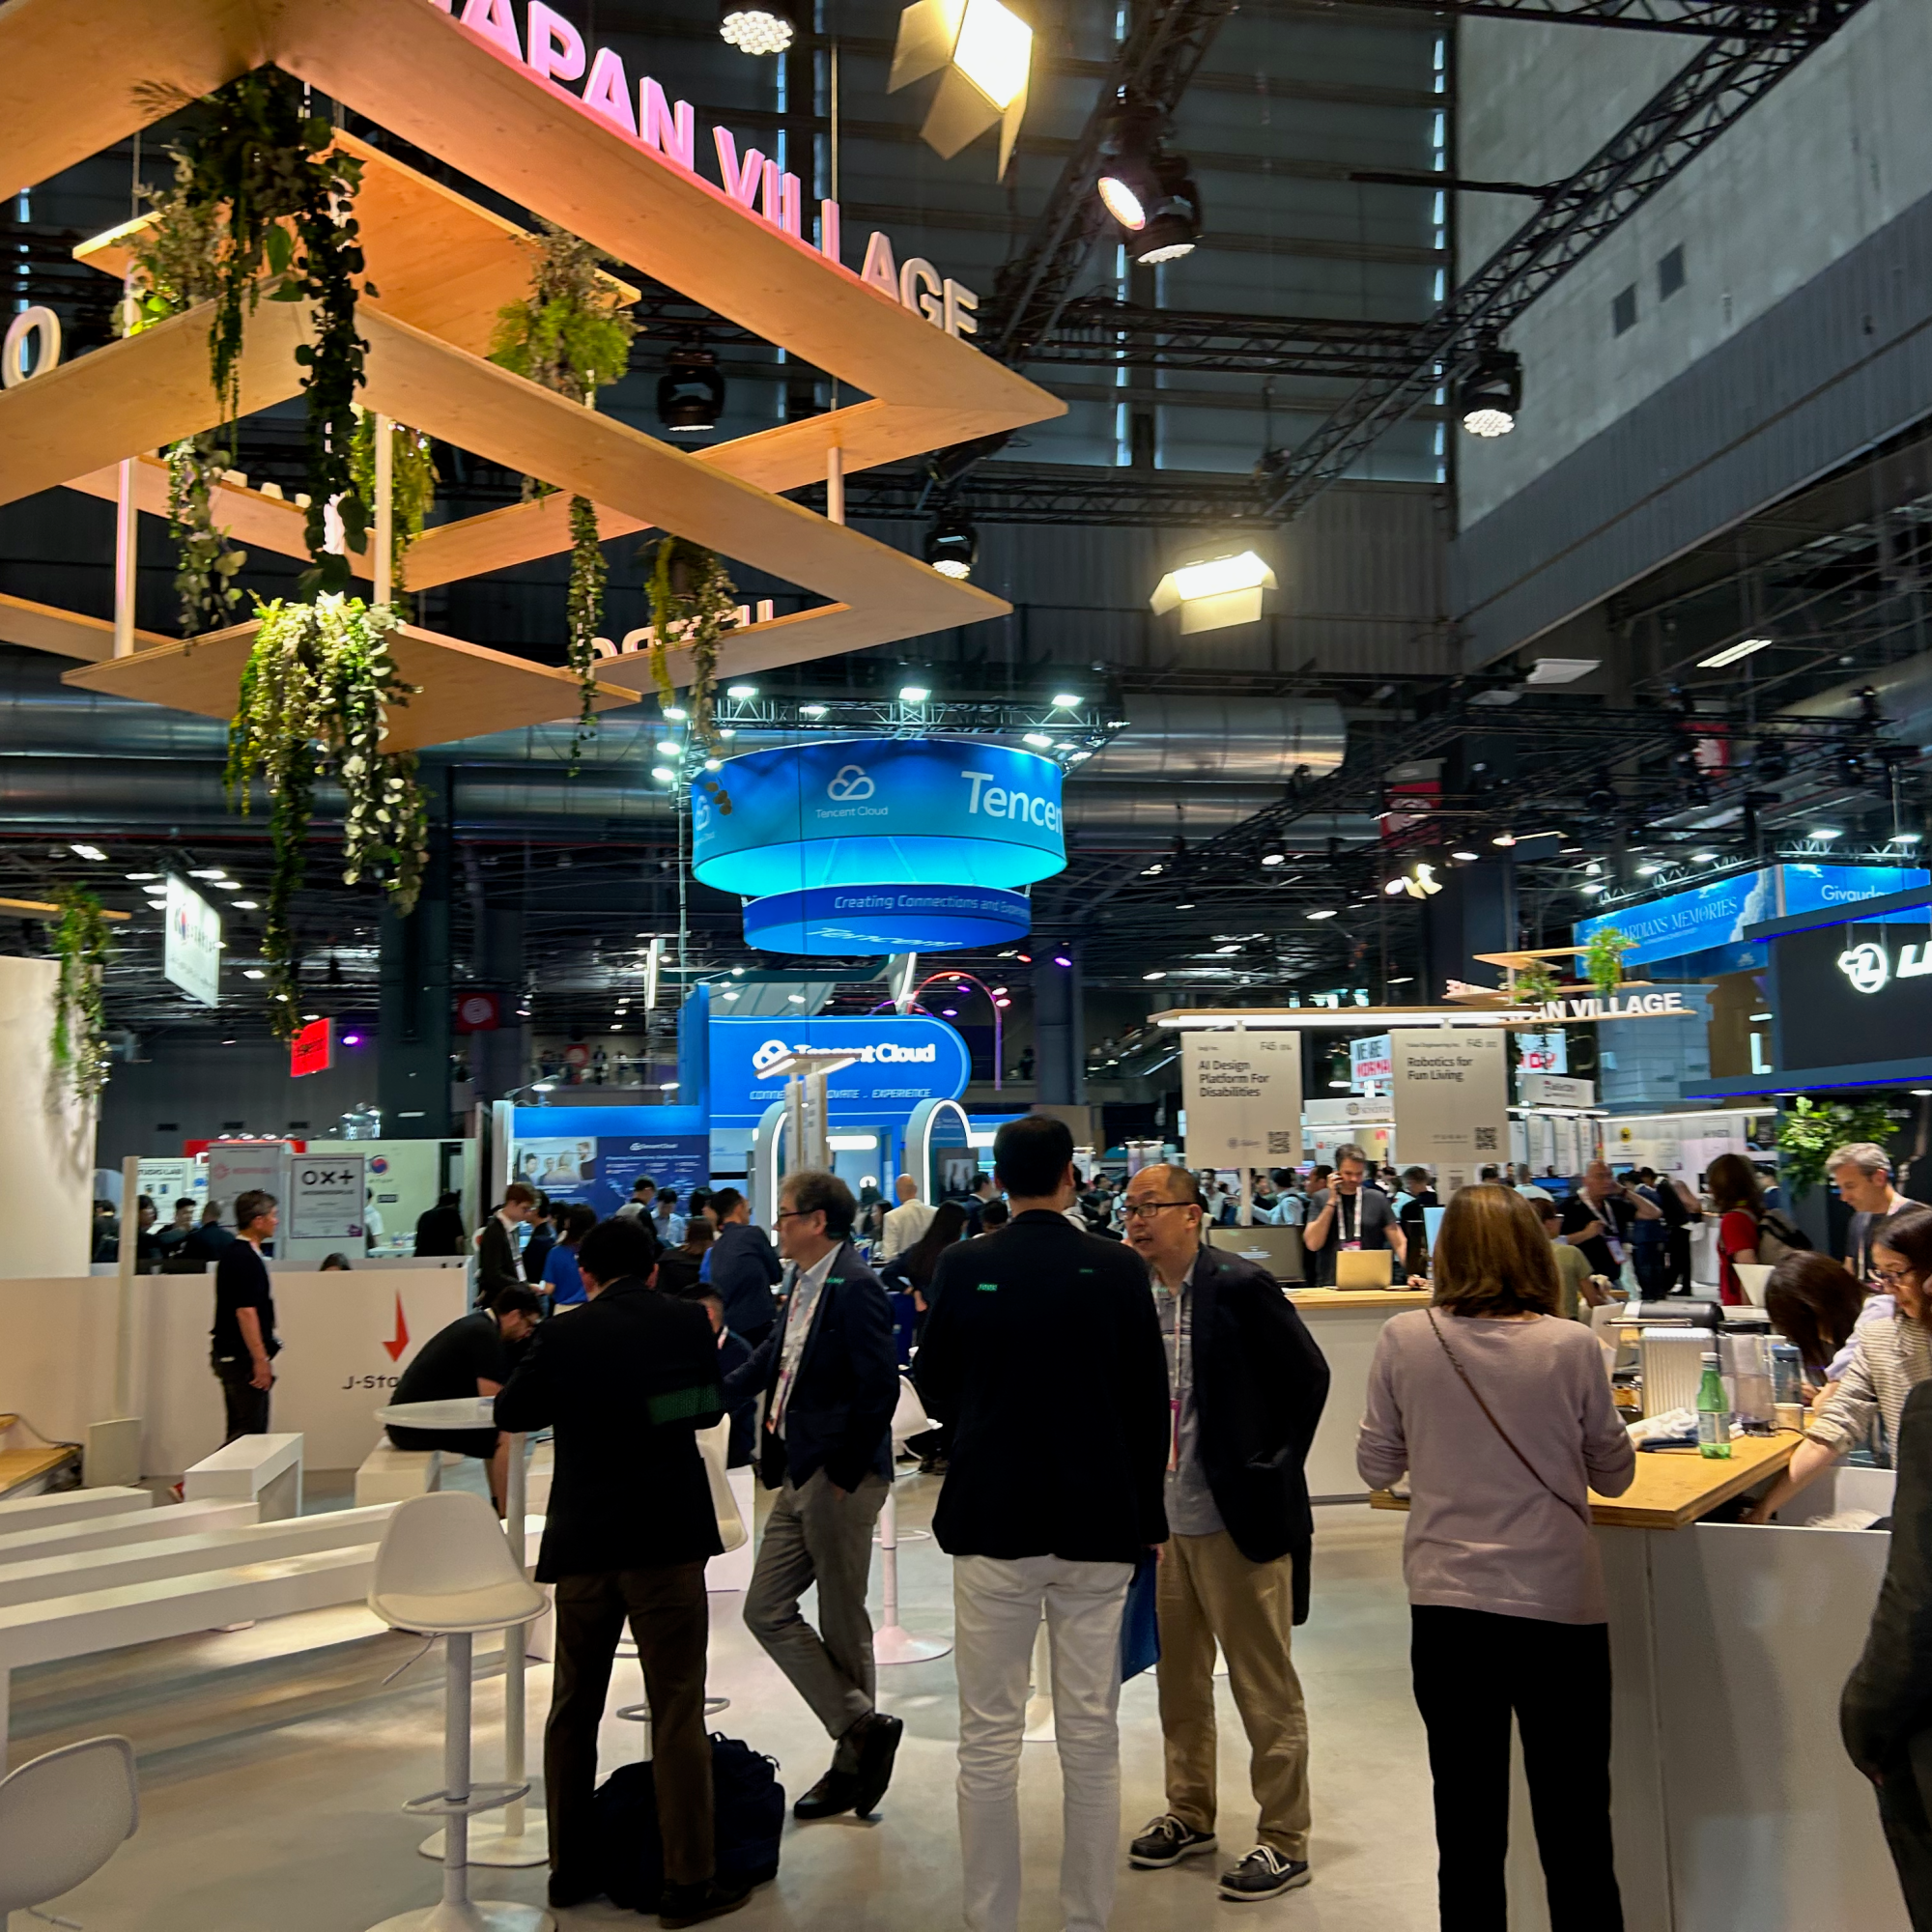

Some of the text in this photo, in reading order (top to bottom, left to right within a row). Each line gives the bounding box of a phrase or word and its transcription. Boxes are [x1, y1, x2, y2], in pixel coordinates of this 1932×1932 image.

[428, 0, 695, 172] APAN
[815, 806, 889, 819] Tencent Cloud
[835, 895, 895, 910] Creating
[897, 895, 980, 909] Connections
[1670, 896, 1738, 930] MEMORIES
[1570, 992, 1684, 1018] VILLAGE
[875, 1042, 936, 1064] Cloud
[1198, 1059, 1251, 1073] AI Design
[1406, 1056, 1474, 1067] Robotics for
[1199, 1073, 1270, 1084] Platform For
[1407, 1069, 1465, 1083] Fun Living
[871, 1088, 932, 1099] EXPERIENCE
[1200, 1087, 1262, 1097] Disabilities
